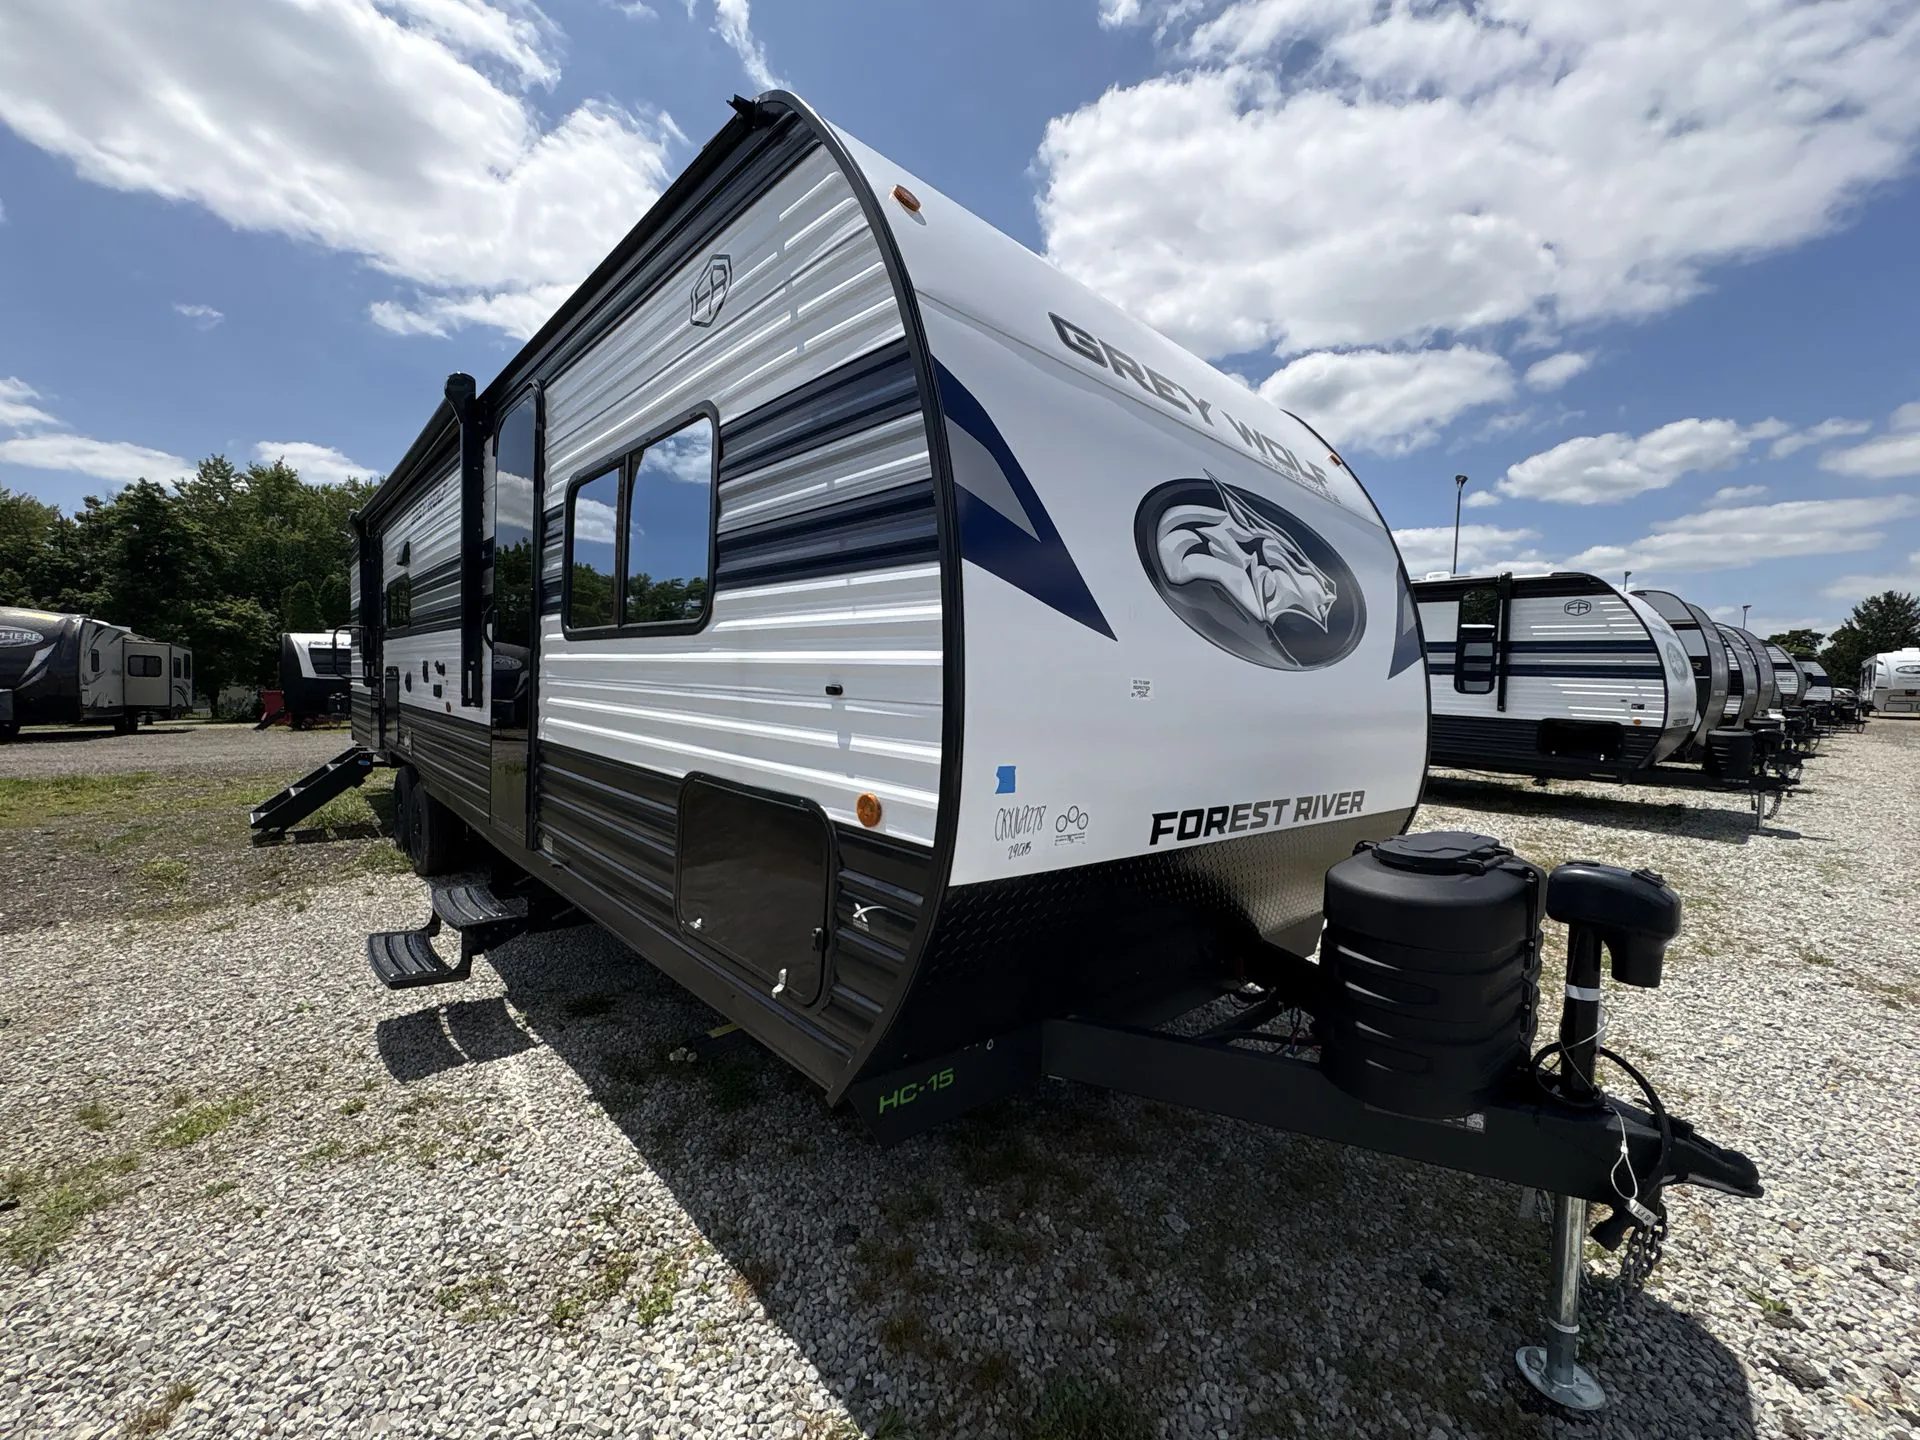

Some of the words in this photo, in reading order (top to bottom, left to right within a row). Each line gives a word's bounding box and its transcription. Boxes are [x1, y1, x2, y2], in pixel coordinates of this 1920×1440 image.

[1048, 312, 1215, 426] GREY
[1221, 410, 1328, 488] WOLF
[0, 632, 40, 641] HERE
[1149, 798, 1290, 846] FOREST
[1293, 790, 1365, 823] RIVER
[878, 1068, 955, 1115] HC-15
